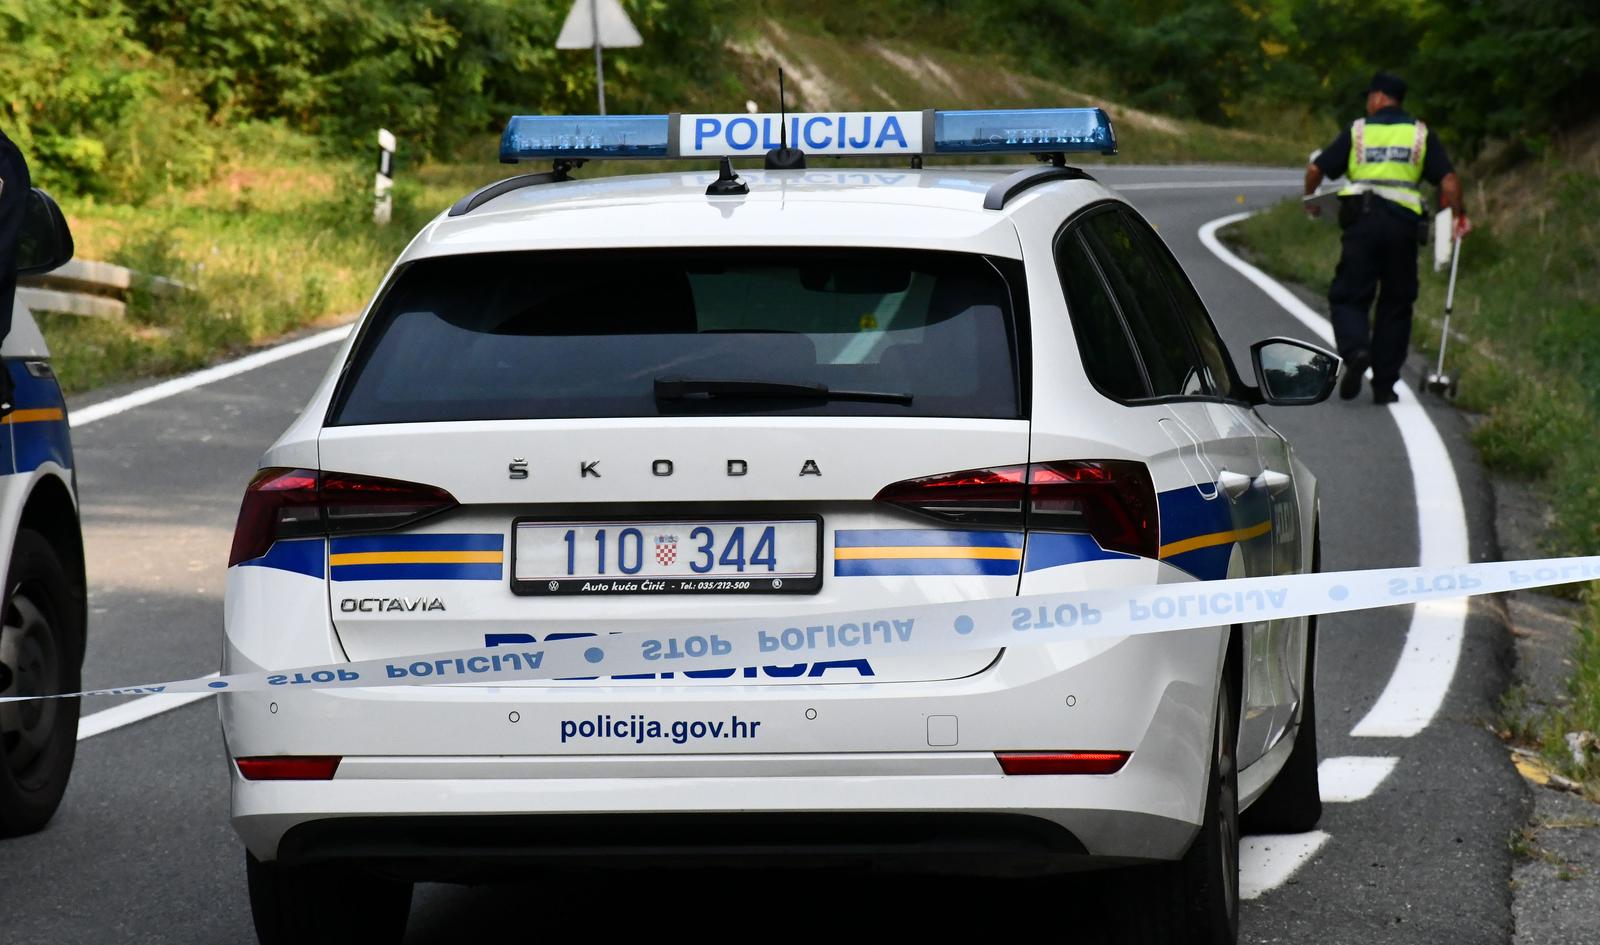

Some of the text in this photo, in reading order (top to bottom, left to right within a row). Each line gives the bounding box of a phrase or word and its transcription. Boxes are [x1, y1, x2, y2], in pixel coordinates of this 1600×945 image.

[695, 115, 909, 152] POLICIJA
[508, 458, 822, 480] ŠKODA
[564, 526, 777, 575] 110 344
[581, 581, 609, 592] Auto
[611, 579, 638, 592] kuća
[680, 581, 697, 590] Tel.:
[697, 580, 750, 590] 035/212-500
[340, 597, 447, 613] OCTAVIA
[560, 715, 761, 744] policija.gov.hr
